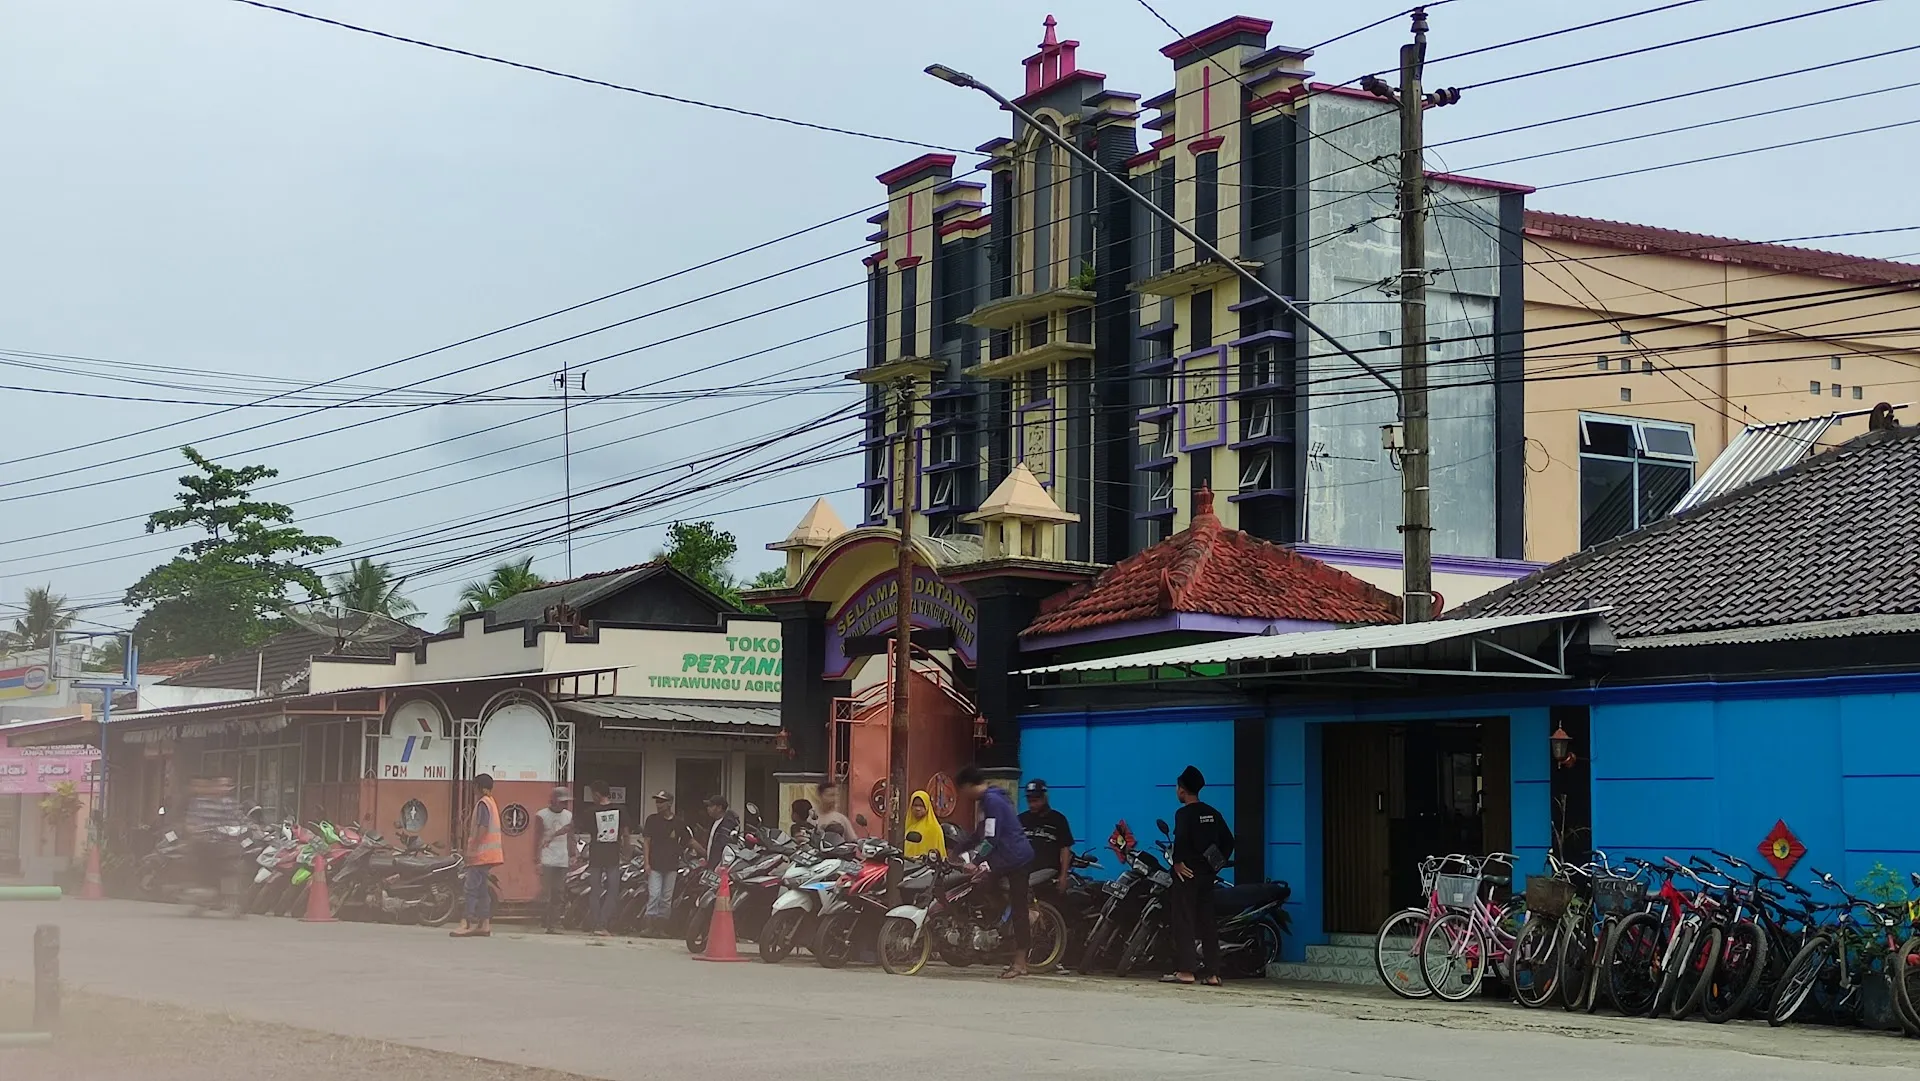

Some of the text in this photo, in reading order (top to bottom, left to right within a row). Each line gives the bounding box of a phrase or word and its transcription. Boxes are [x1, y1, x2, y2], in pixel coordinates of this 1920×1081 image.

[837, 577, 976, 637] SELAMA DATANG
[726, 636, 781, 653] TOKO
[648, 676, 741, 691] TIRTAWUNGU
[384, 764, 447, 779] POM MINI
